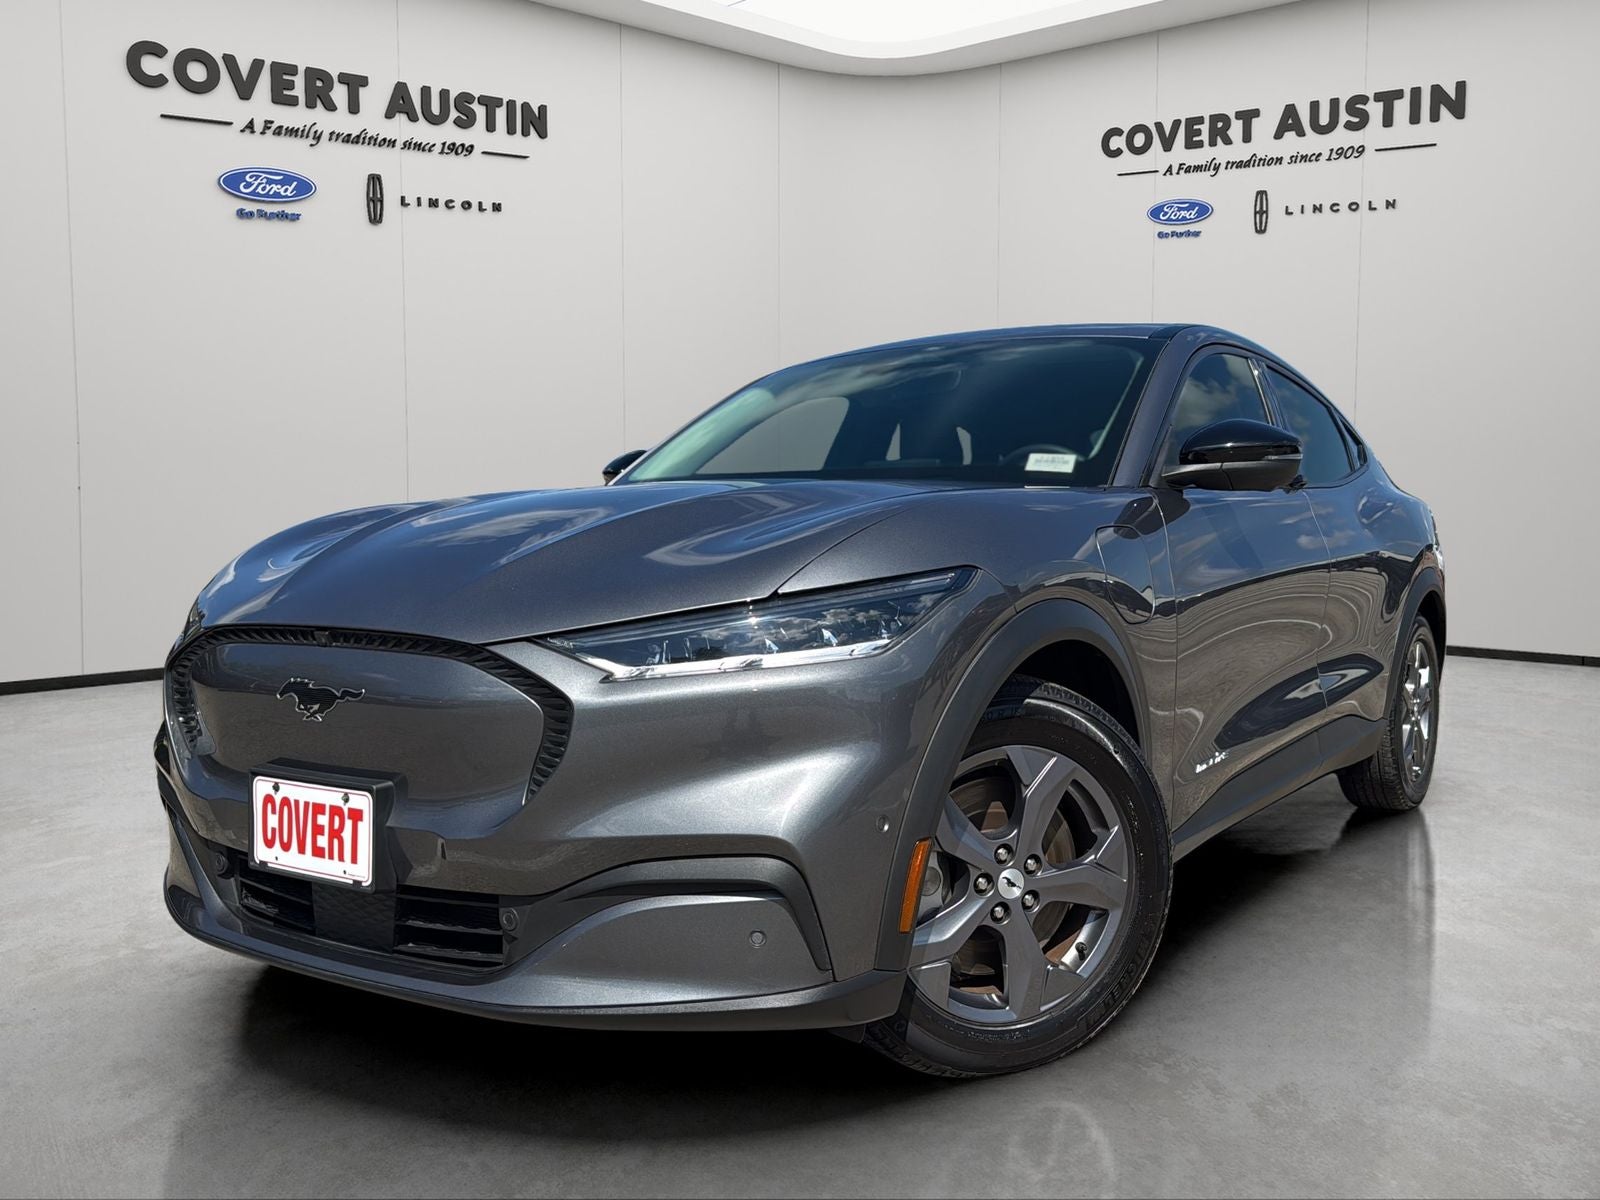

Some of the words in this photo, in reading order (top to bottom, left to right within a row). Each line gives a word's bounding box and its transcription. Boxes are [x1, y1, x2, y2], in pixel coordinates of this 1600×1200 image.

[126, 40, 369, 116] COVERT
[385, 80, 548, 139] AUSTIN
[1100, 108, 1260, 159] COVERT
[1273, 80, 1467, 140] AUSTIN
[240, 117, 256, 135] A
[260, 119, 324, 147] Family
[328, 128, 398, 149] tradition
[400, 137, 437, 153] since
[438, 141, 475, 157] 1909
[1162, 163, 1174, 176] A
[1176, 157, 1222, 178] Family
[1225, 152, 1284, 170] tradition
[1287, 151, 1323, 165] since
[1325, 144, 1366, 161] 1909
[239, 172, 298, 197] Ford
[400, 195, 503, 213] LINCOLN
[1160, 203, 1199, 220] Ford
[1284, 198, 1398, 216] LINCOLN
[261, 793, 364, 865] COVERT
